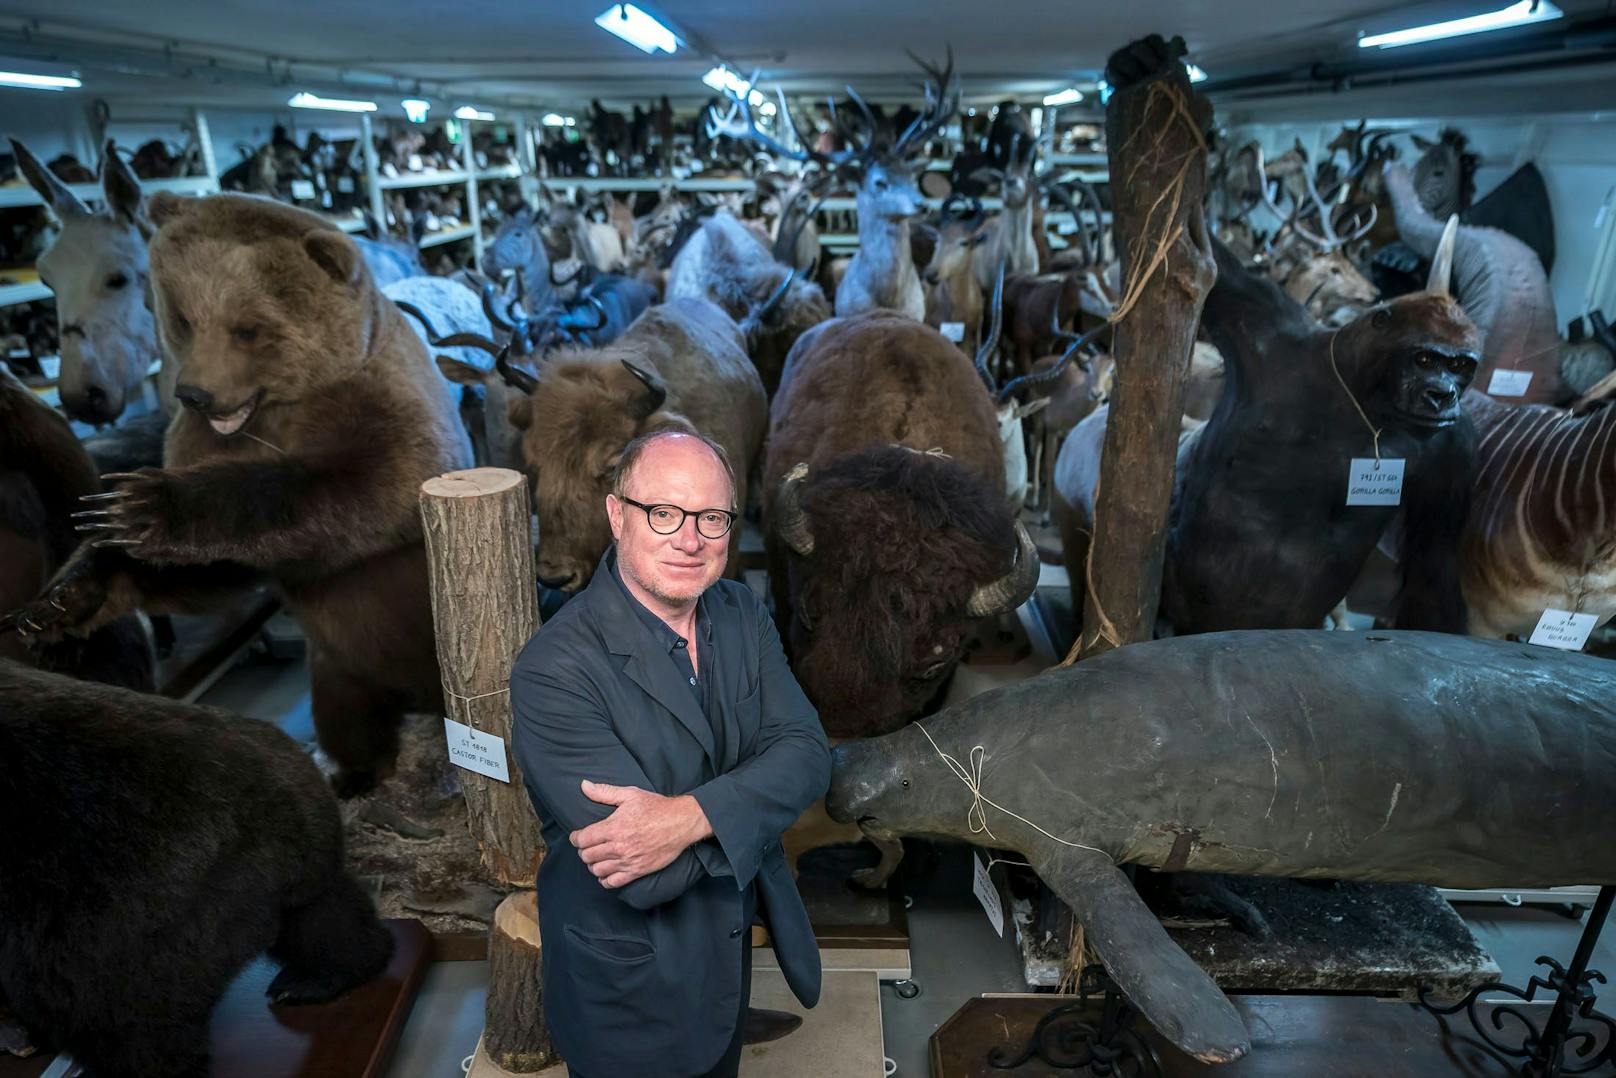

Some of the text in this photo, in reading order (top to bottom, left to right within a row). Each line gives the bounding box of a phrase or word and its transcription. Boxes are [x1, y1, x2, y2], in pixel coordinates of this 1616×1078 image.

[1351, 487, 1400, 495] GORILLA GORILLA
[461, 739, 470, 748] ST
[451, 747, 501, 769] CASTOR FIBER
